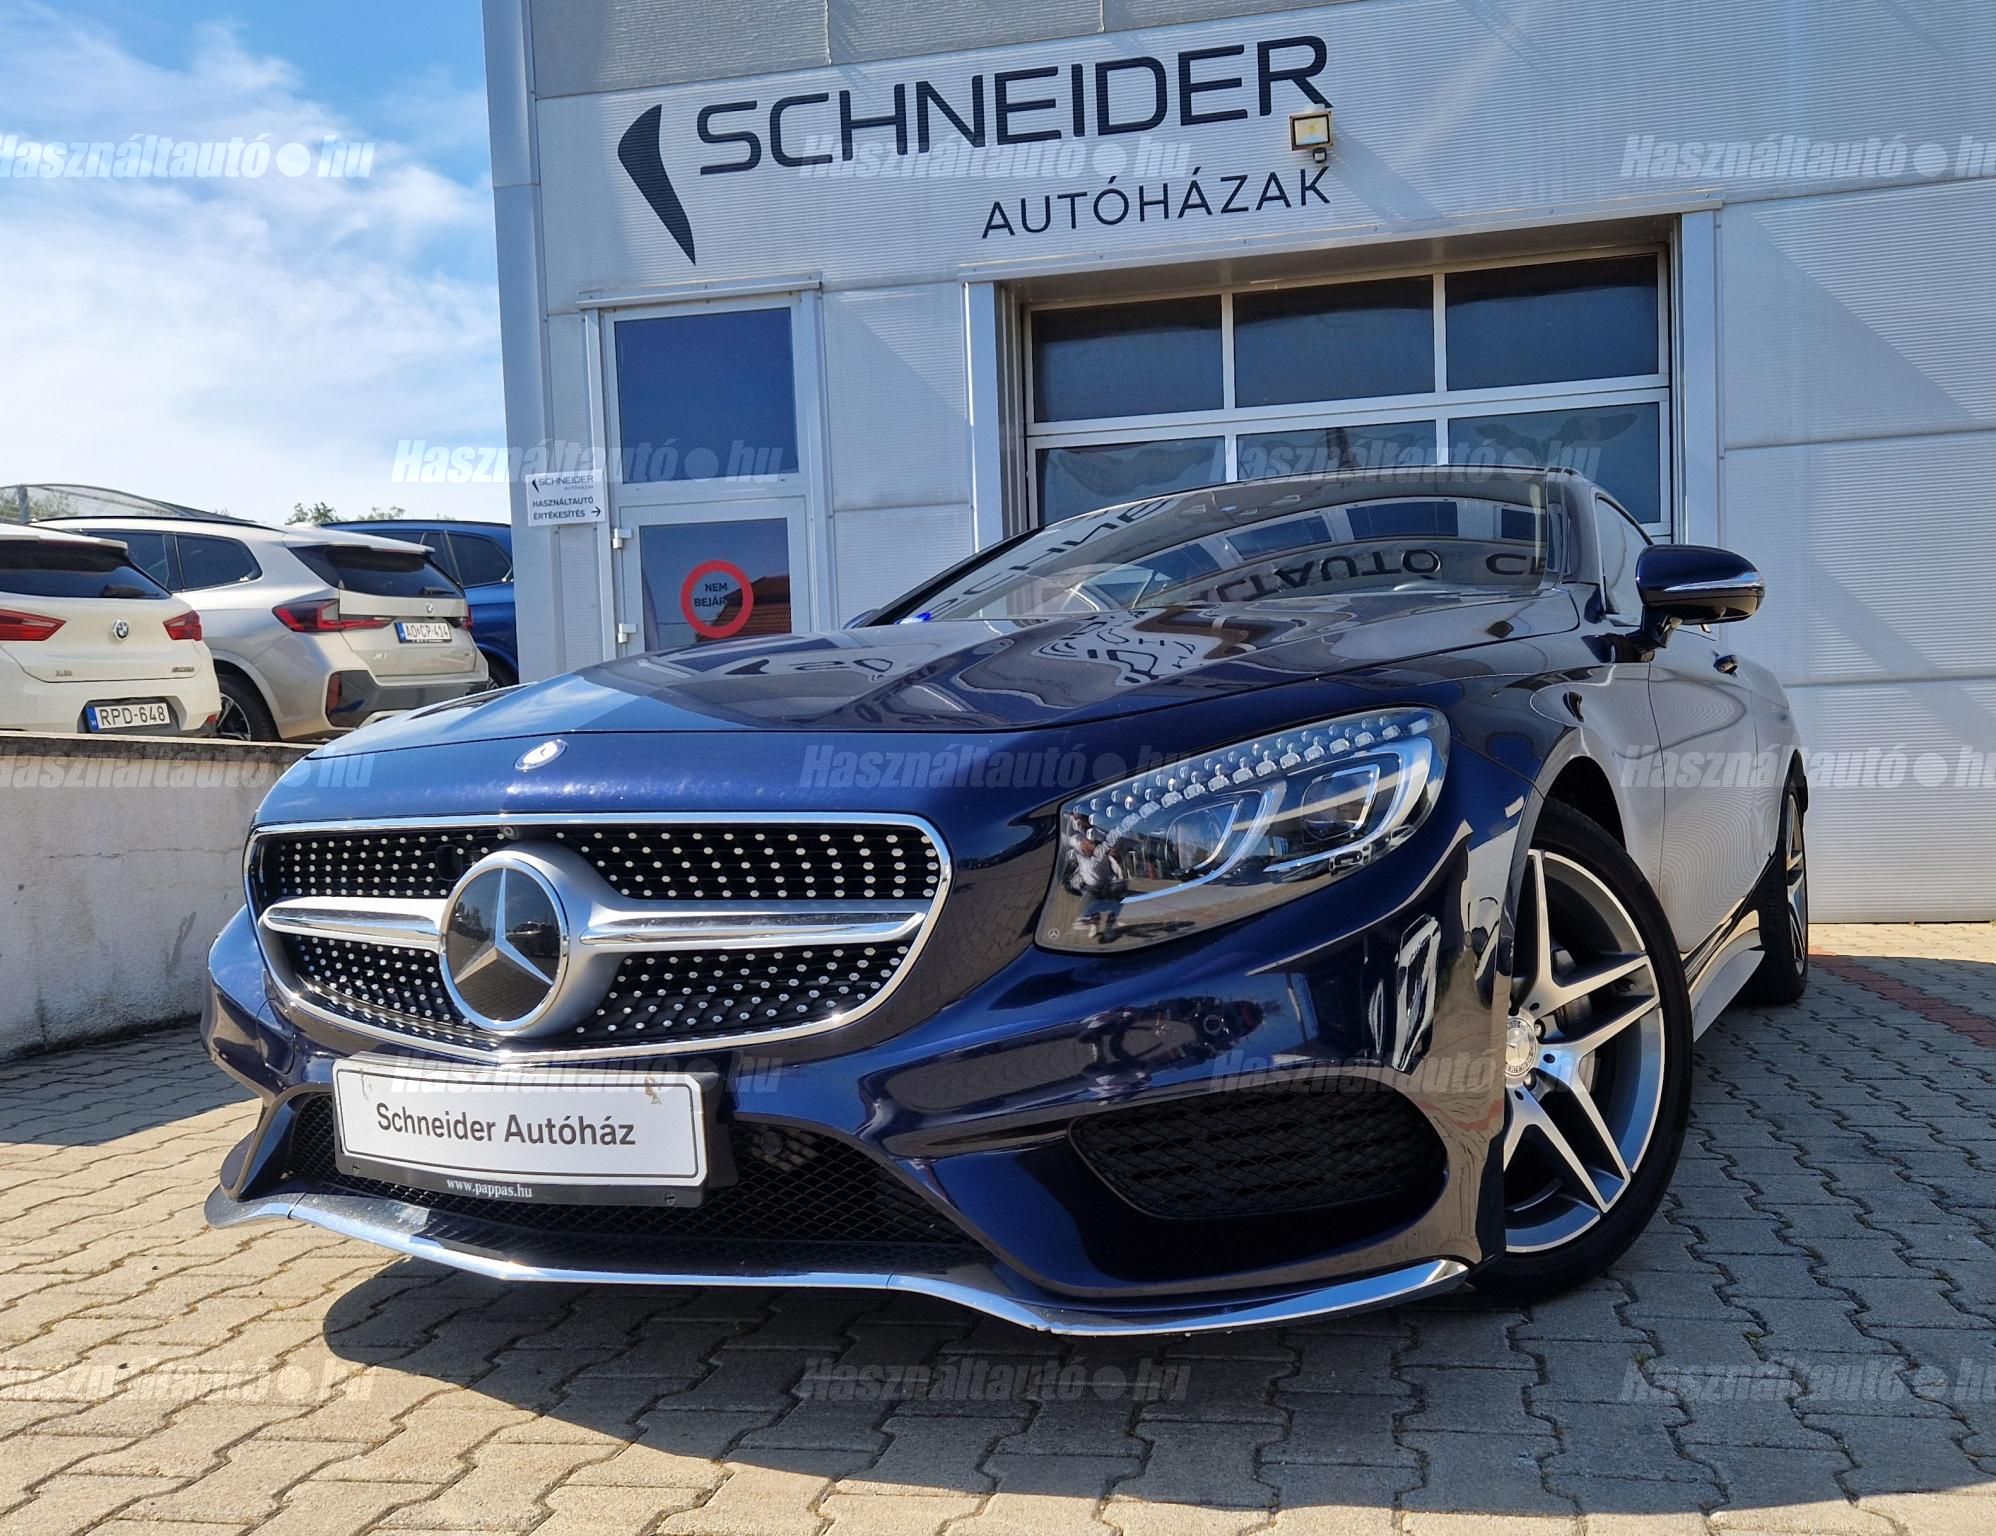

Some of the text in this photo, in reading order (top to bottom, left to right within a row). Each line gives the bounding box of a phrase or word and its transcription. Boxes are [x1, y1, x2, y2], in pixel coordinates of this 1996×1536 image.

[697, 35, 1333, 176] SCHNEIDER
[981, 166, 1330, 239] AUTÓHÁZAK
[538, 475, 594, 486] SCHNEIDER
[532, 496, 594, 508] HASZNÁLTAUTÓ
[533, 509, 586, 520] ÉRTÉKESÍTÉS
[705, 582, 728, 592] NEM
[694, 594, 736, 608] BEJÁR
[100, 705, 166, 726] RPD-648
[376, 1102, 636, 1146] Schneider Autóház
[446, 1178, 533, 1199] www.pappas.hu
